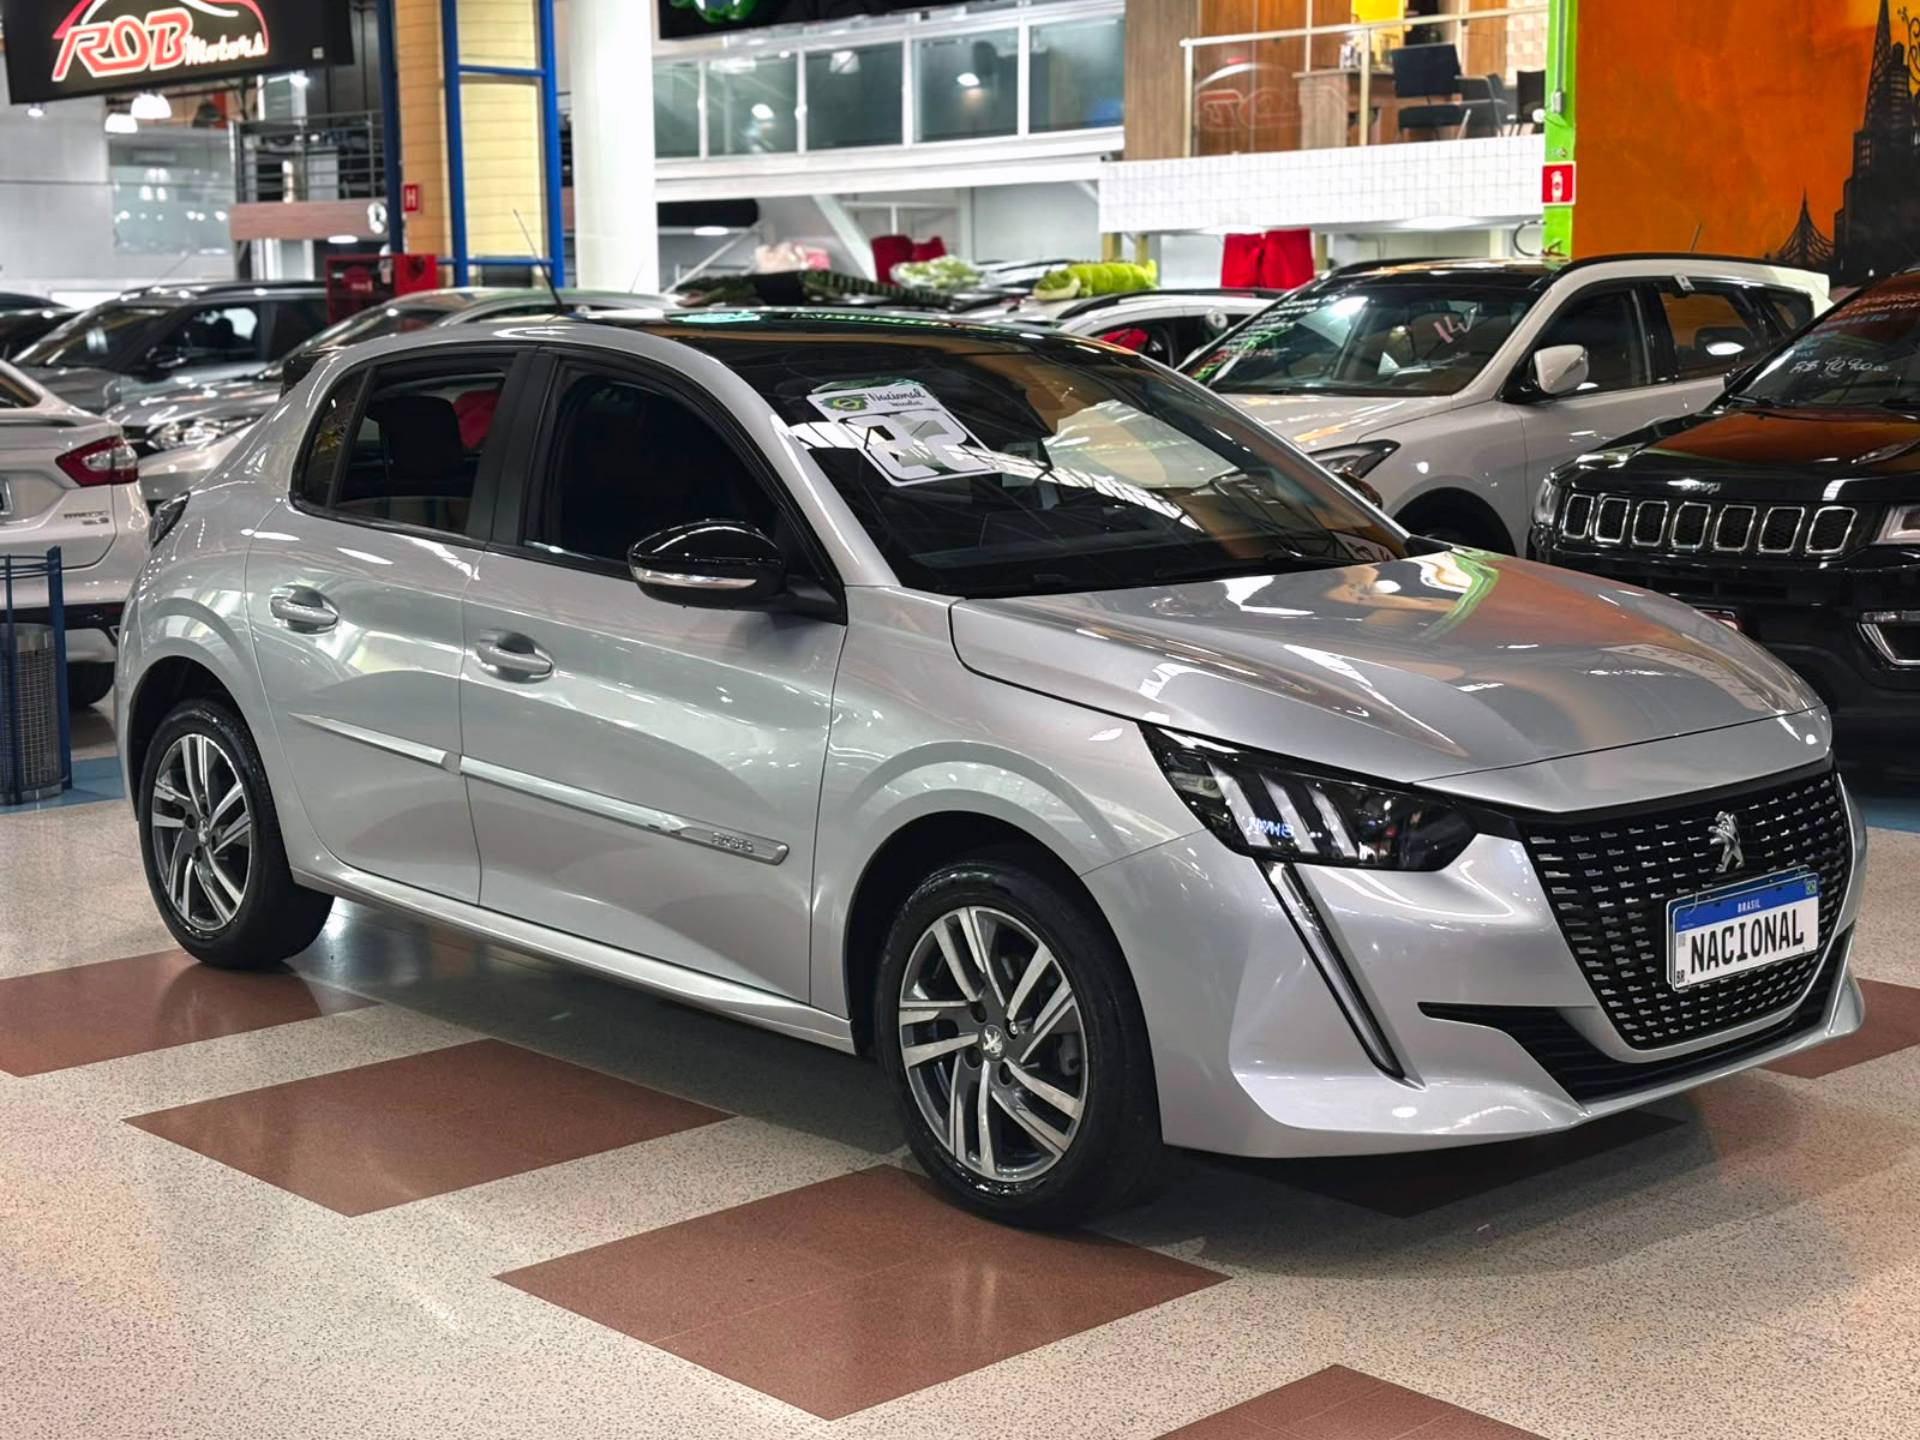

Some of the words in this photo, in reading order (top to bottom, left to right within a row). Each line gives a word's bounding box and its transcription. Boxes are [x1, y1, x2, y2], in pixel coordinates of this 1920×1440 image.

[51, 7, 193, 82] ROB
[867, 387, 926, 402] Nacional
[1737, 898, 1761, 913] BRASIL
[1691, 908, 1804, 975] NACIONAL
